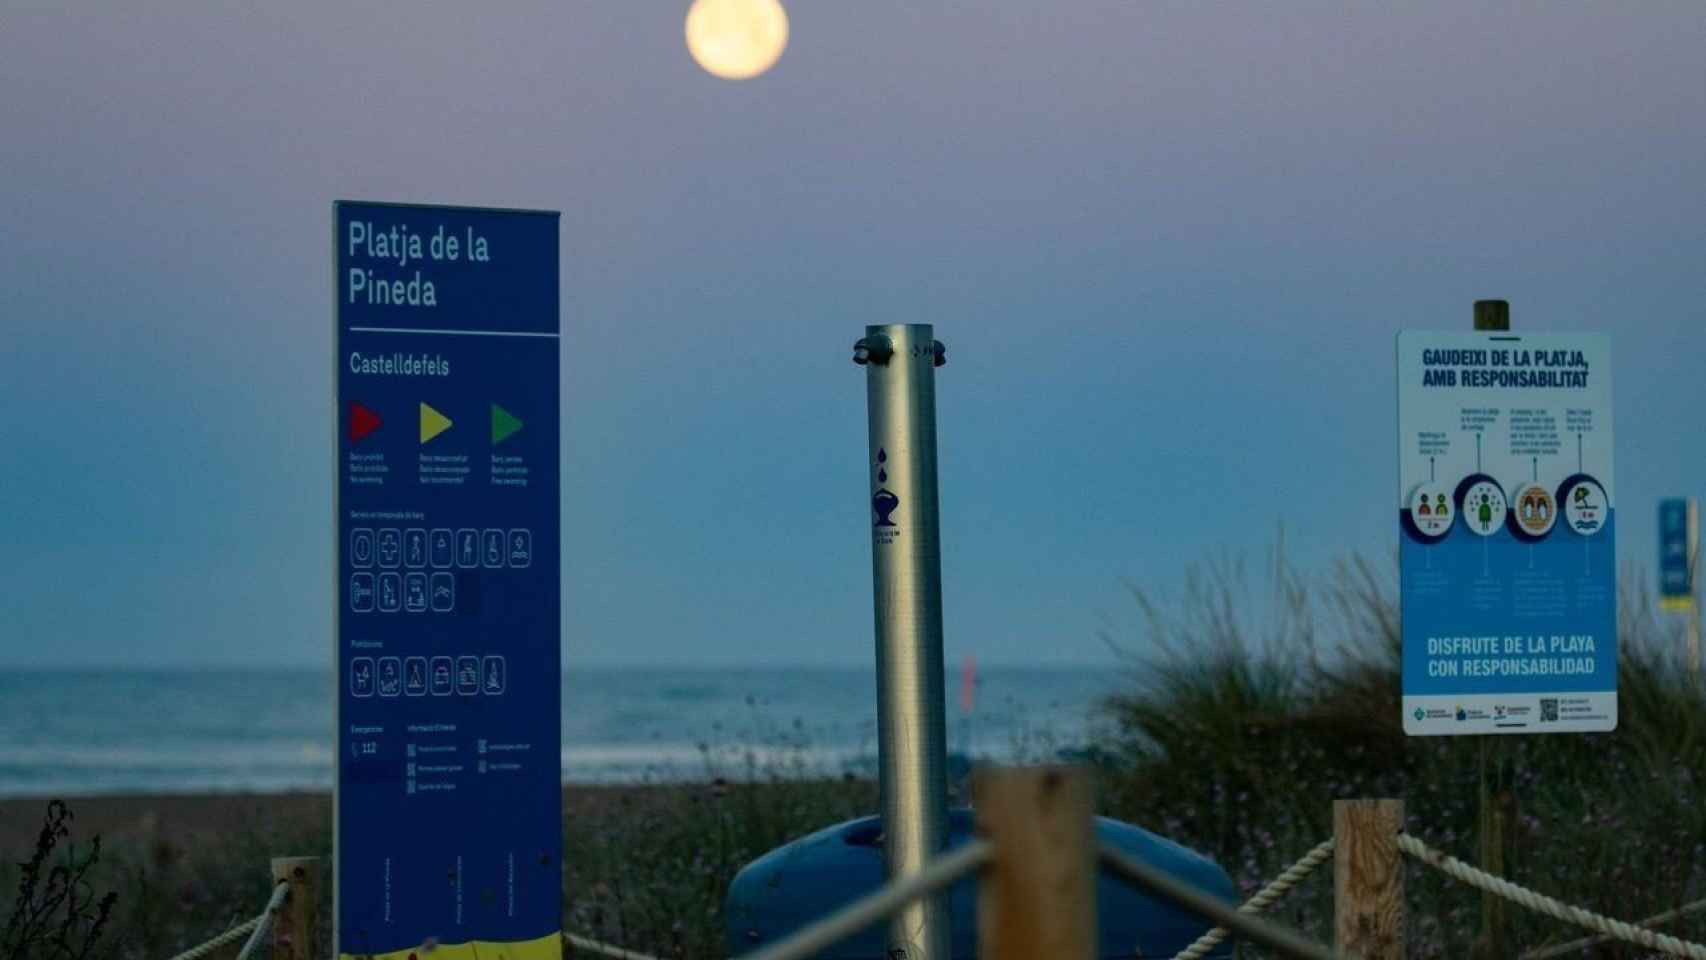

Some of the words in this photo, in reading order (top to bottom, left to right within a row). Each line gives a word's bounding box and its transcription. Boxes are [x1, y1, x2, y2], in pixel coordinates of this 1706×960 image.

[349, 220, 423, 267] Platja
[430, 225, 459, 260] de
[467, 226, 490, 262] la
[350, 268, 437, 306] Pineda
[350, 351, 449, 376] Castelldefels
[1423, 349, 1487, 366] GAUDEIXI
[1491, 350, 1510, 367] DE
[1513, 350, 1531, 367] LA
[1535, 350, 1589, 370] PLATJA,
[1423, 369, 1457, 387] AMB
[1461, 370, 1589, 388] RESPONSABILITAT
[1428, 637, 1500, 655] DISFRUTE
[1504, 637, 1523, 654] DE
[1528, 636, 1546, 653] LA
[1551, 635, 1595, 653] PLAYA
[1428, 660, 1458, 677] CON
[1463, 657, 1595, 677] RESPONSABILIDAD
[363, 741, 377, 754] 112
